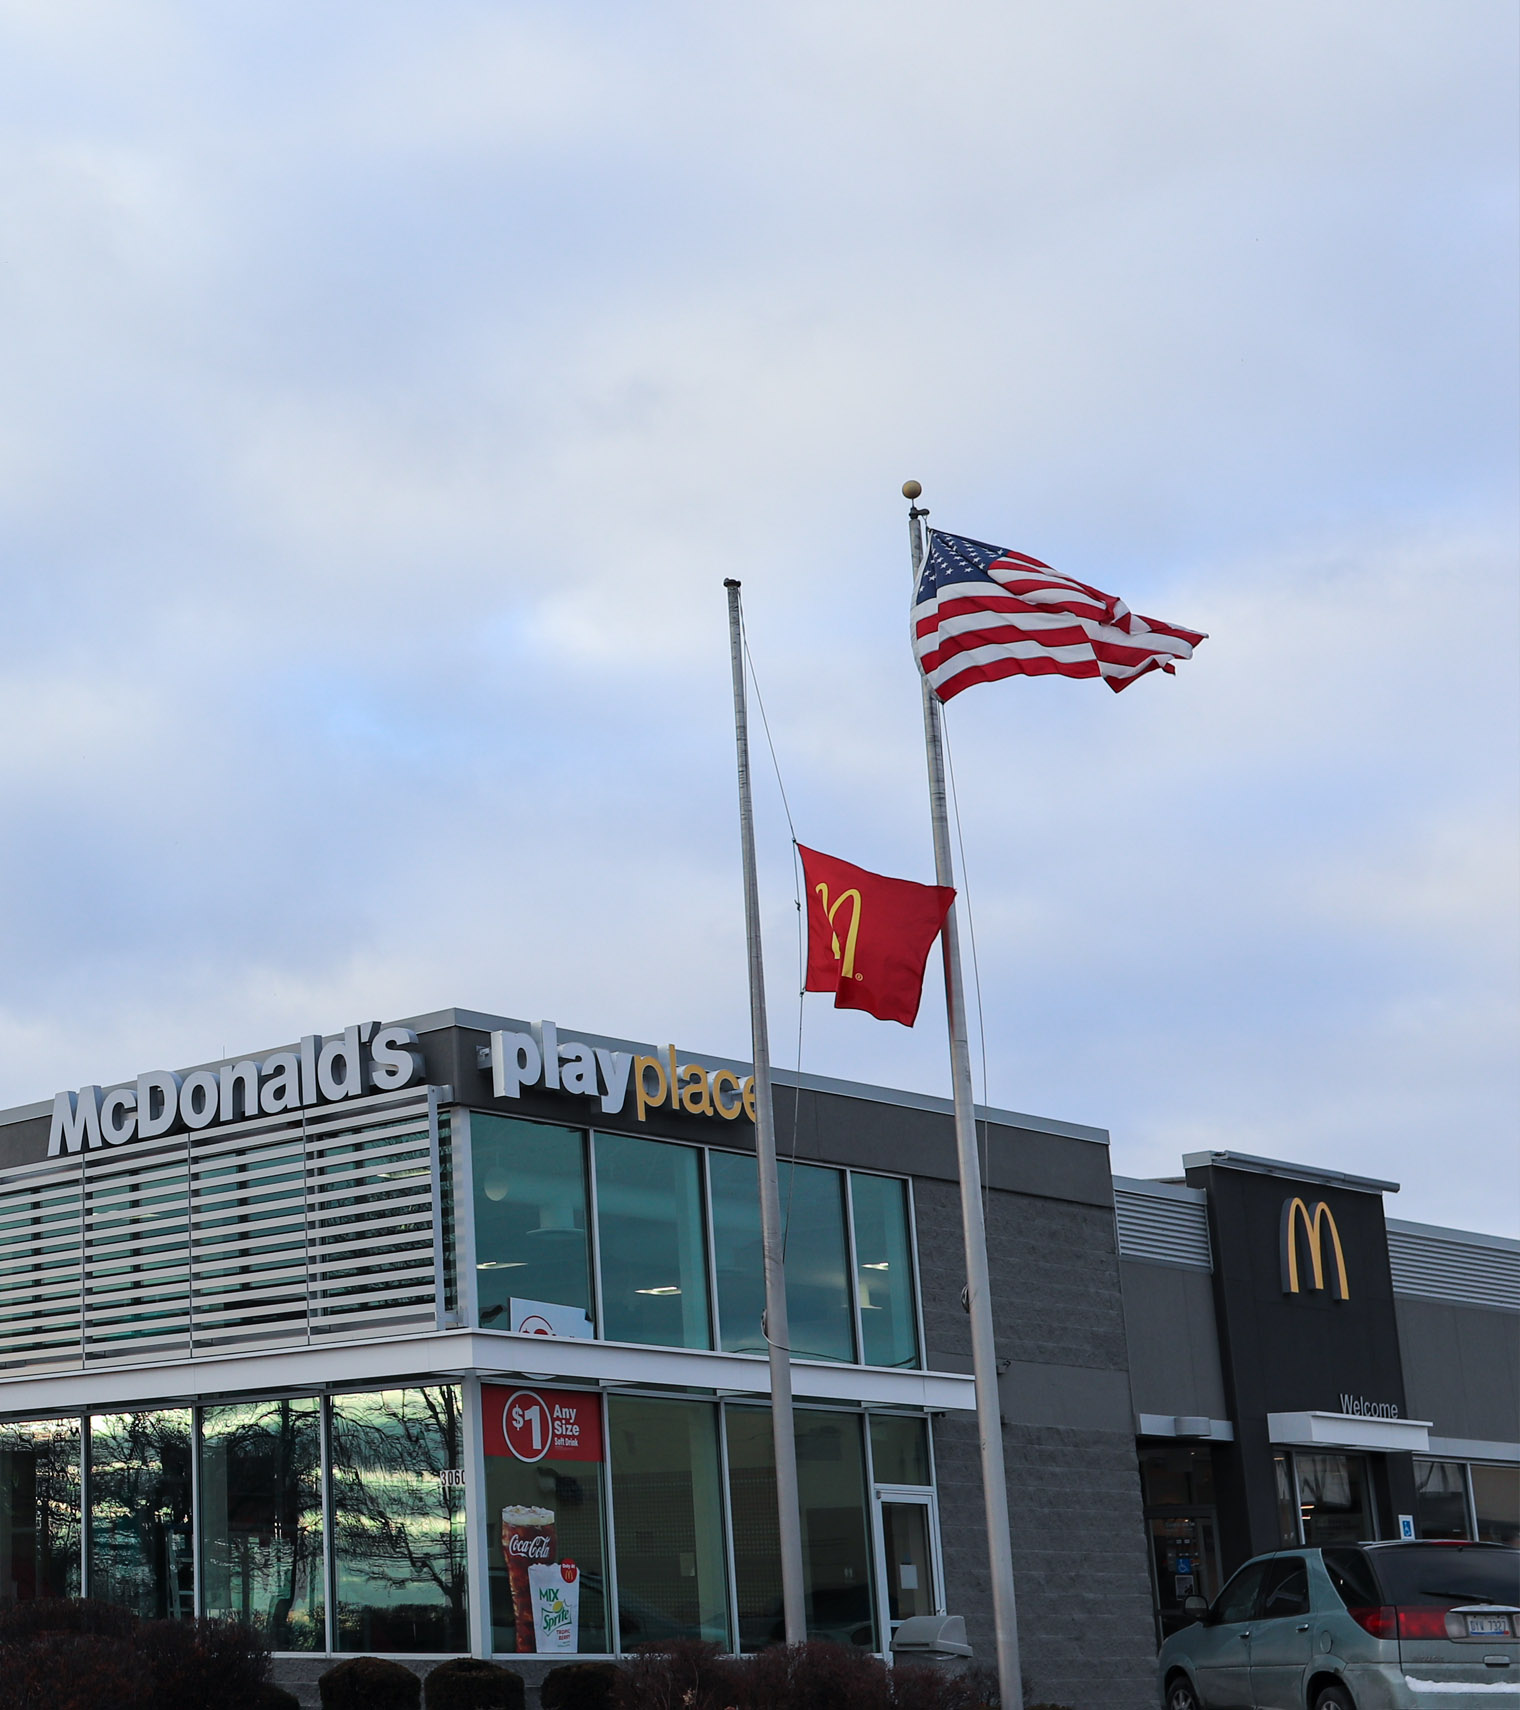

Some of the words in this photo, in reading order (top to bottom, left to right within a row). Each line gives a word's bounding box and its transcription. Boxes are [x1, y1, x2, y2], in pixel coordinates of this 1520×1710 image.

[47, 1020, 424, 1157] McDonald's
[553, 1404, 577, 1423] Any
[1339, 1393, 1399, 1420] Welcome
[512, 1403, 543, 1450] $1
[553, 1419, 580, 1436] Size
[554, 1437, 565, 1446] Soft
[539, 1587, 560, 1602] MIX
[543, 1607, 570, 1632] Sprite
